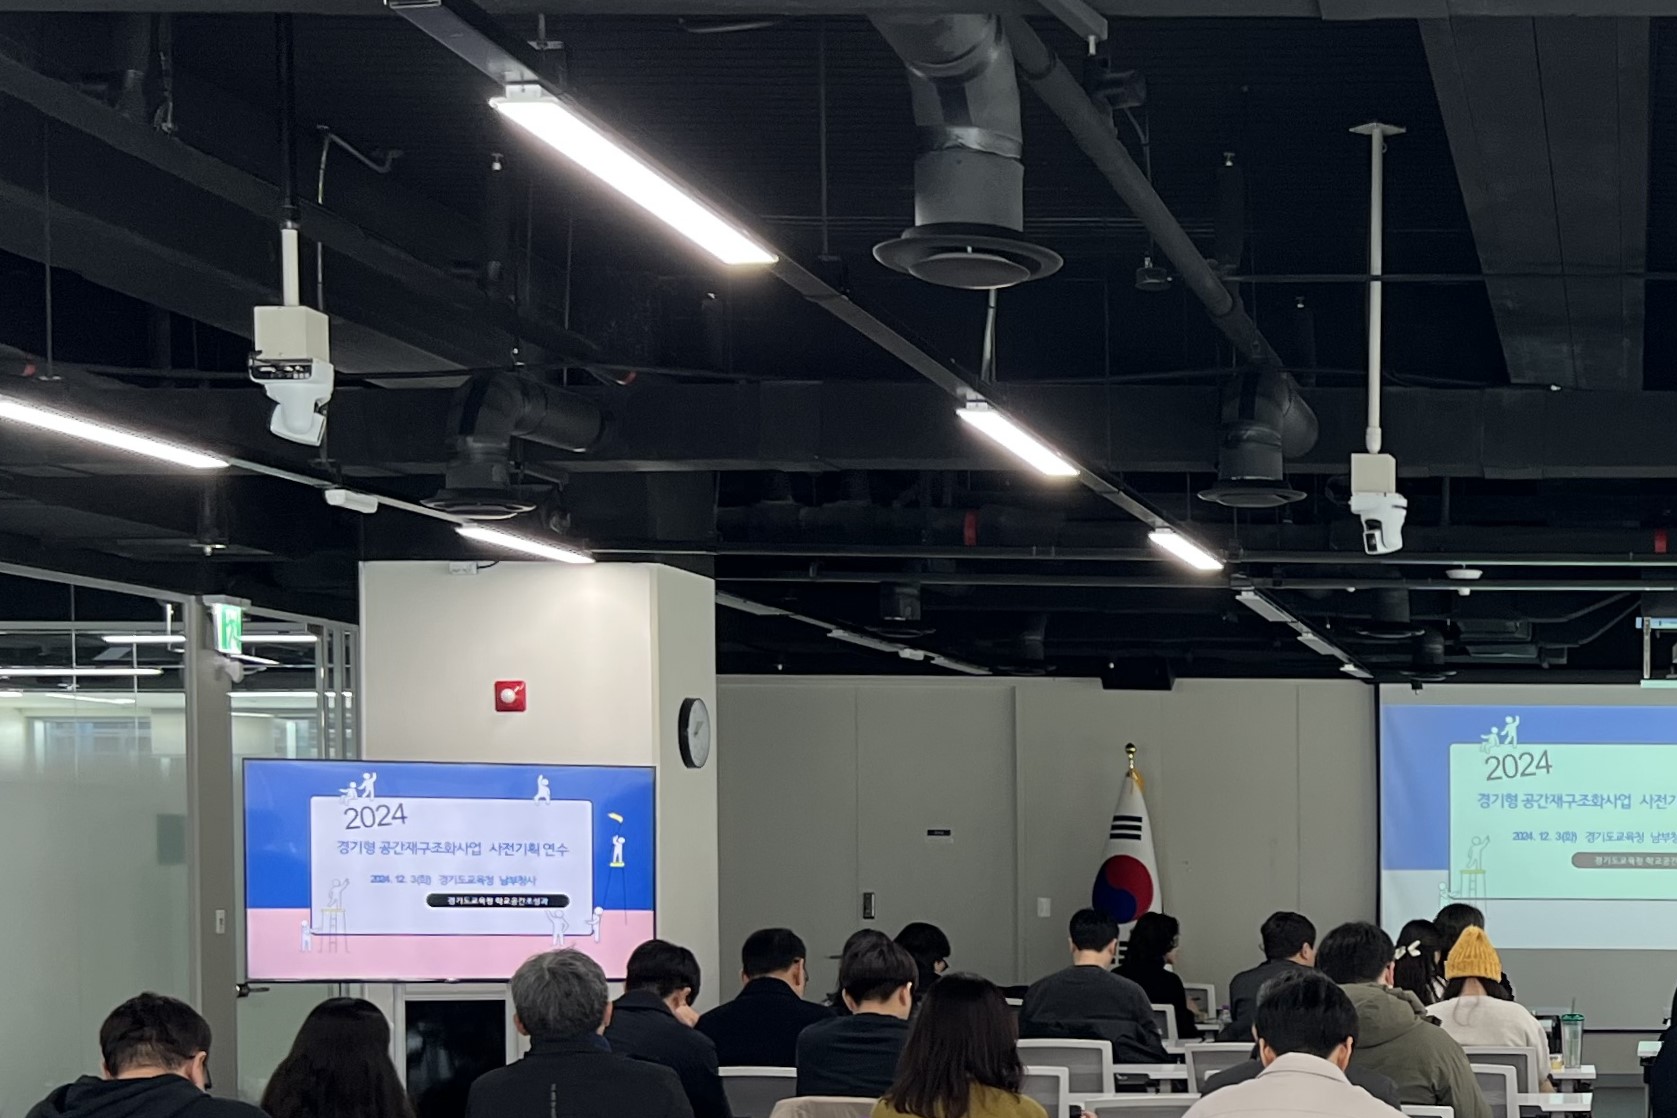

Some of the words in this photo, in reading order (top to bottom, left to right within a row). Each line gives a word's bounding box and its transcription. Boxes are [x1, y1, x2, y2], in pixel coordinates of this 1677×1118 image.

[1484, 749, 1553, 782] 2024
[1477, 793, 1519, 810] 경기형
[1521, 793, 1632, 810] 공간재구조화사업
[344, 802, 409, 830] 2024
[1585, 831, 1645, 844] 경기도교육청
[337, 840, 376, 856] 경기형
[379, 840, 482, 857] 공간재구조화사업
[488, 841, 541, 857] 사전기획
[542, 842, 570, 857] 연수
